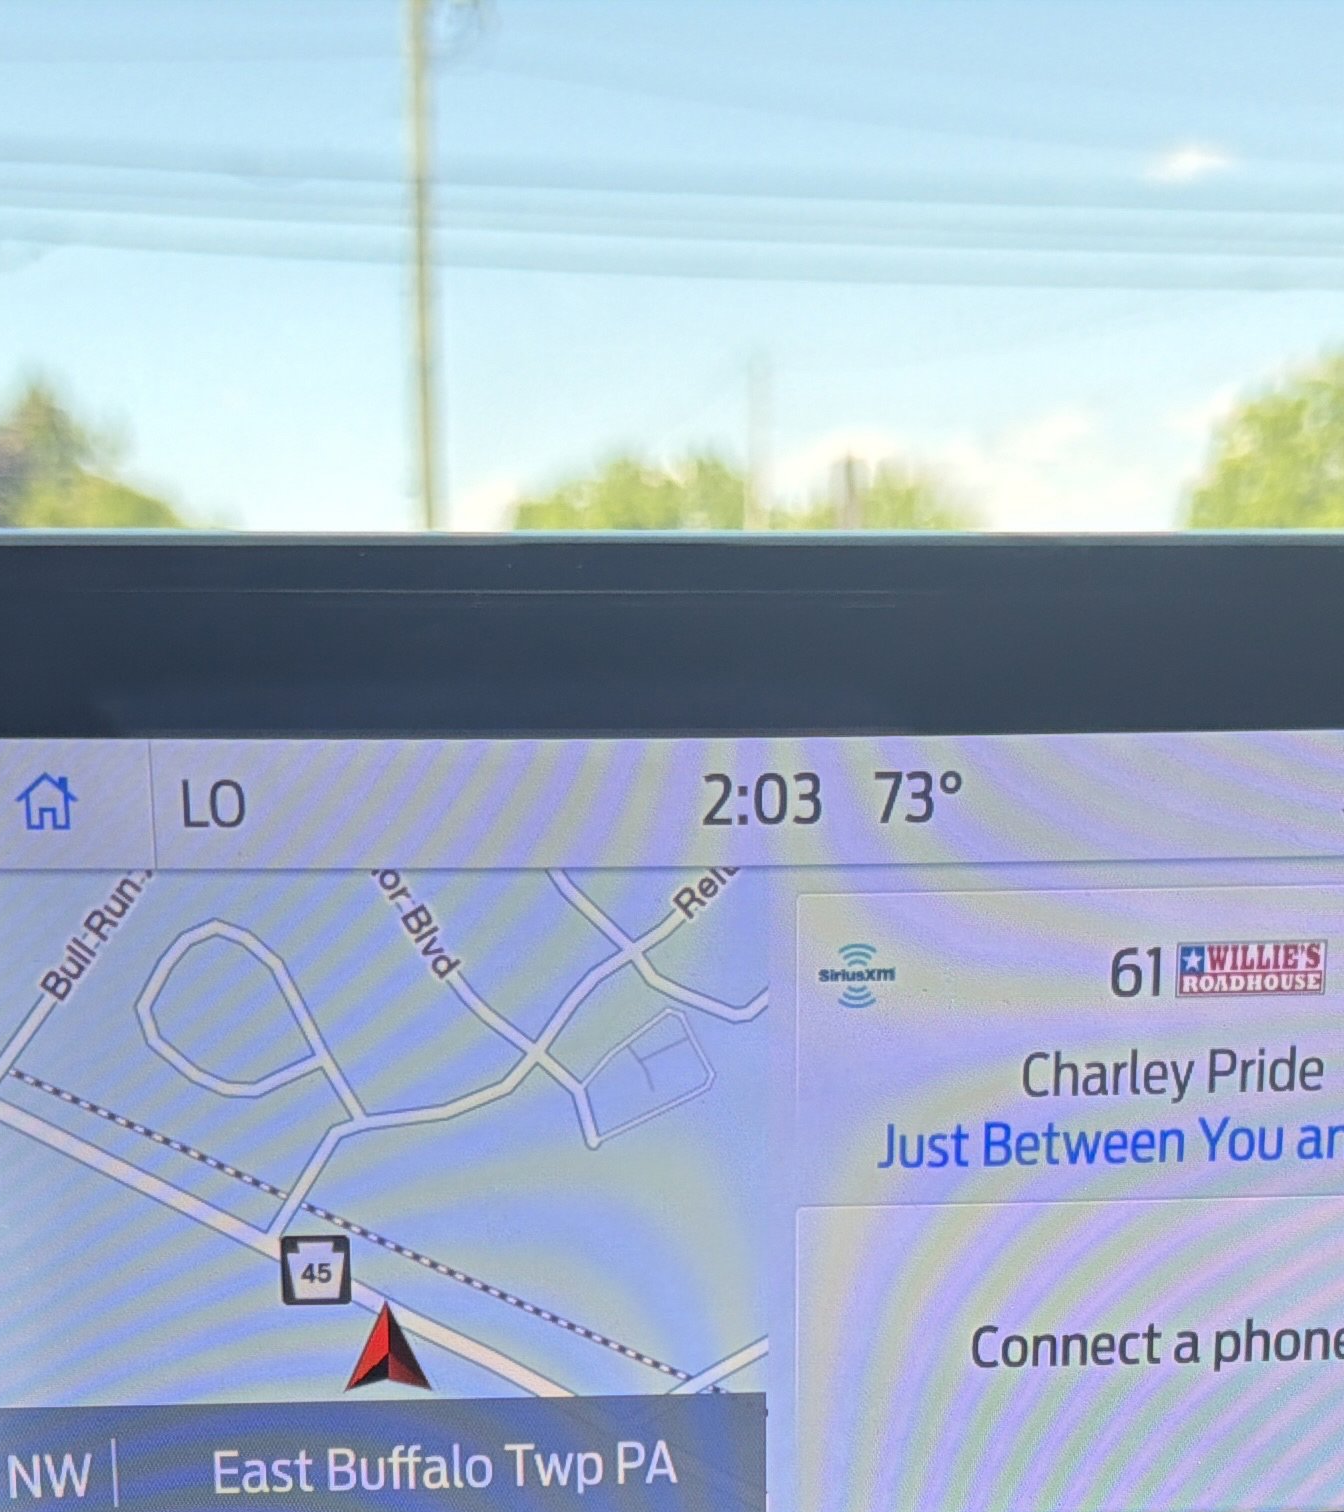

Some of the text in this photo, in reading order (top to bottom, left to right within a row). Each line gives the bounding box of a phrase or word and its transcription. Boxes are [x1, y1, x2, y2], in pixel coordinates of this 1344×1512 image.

[181, 778, 247, 830] LO
[702, 772, 823, 827] 2:03
[40, 936, 97, 1001] Bull
[83, 877, 142, 942] Run
[371, 868, 461, 980] or Blvd
[1110, 946, 1161, 998] 61
[1206, 941, 1322, 972] WILLIE'S
[1181, 972, 1322, 995] ROADHOUSE
[1022, 1046, 1326, 1103] Charley Pride
[877, 1122, 970, 1170] Just
[982, 1119, 1187, 1168] Between
[1197, 1116, 1285, 1164] You
[300, 1262, 333, 1285] 45
[971, 1322, 1163, 1369] Connect
[1173, 1329, 1201, 1364] a
[7, 1452, 93, 1499] NW
[213, 1440, 679, 1495] East Buffalo Twp PA
